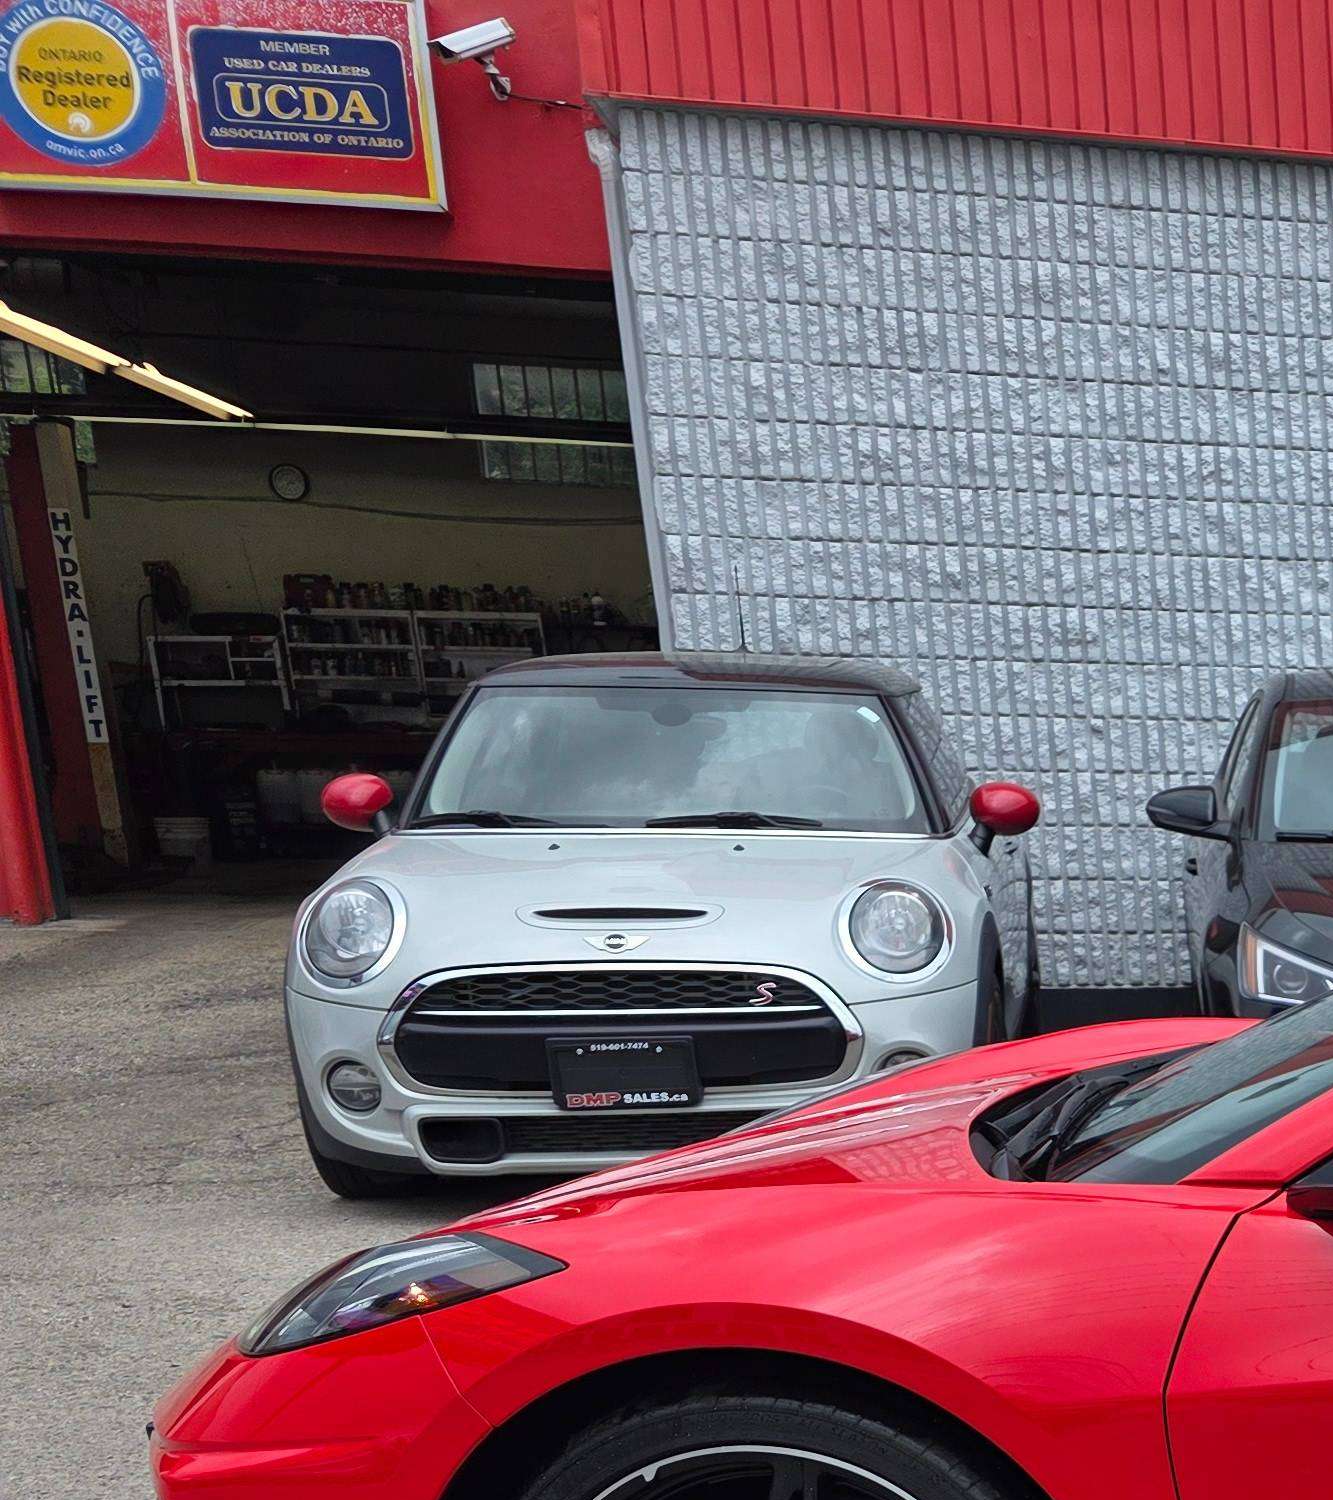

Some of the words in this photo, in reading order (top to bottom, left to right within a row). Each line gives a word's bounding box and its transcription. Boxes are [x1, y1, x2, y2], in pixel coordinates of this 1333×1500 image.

[43, 0, 160, 80] CONFIDENCE
[260, 40, 330, 56] MEMBER
[38, 47, 105, 63] ONTARIO
[17, 65, 131, 89] Registered
[224, 57, 265, 70] USED
[269, 60, 299, 73] CAR
[301, 62, 371, 78] DEALERS
[42, 89, 113, 110] Dealer
[225, 81, 380, 126] UCDA
[209, 126, 310, 143] ASSOCIATION
[313, 132, 333, 145] OF
[337, 134, 404, 149] ONTARIO
[749, 982, 777, 1006] S
[566, 1091, 622, 1108] DMP
